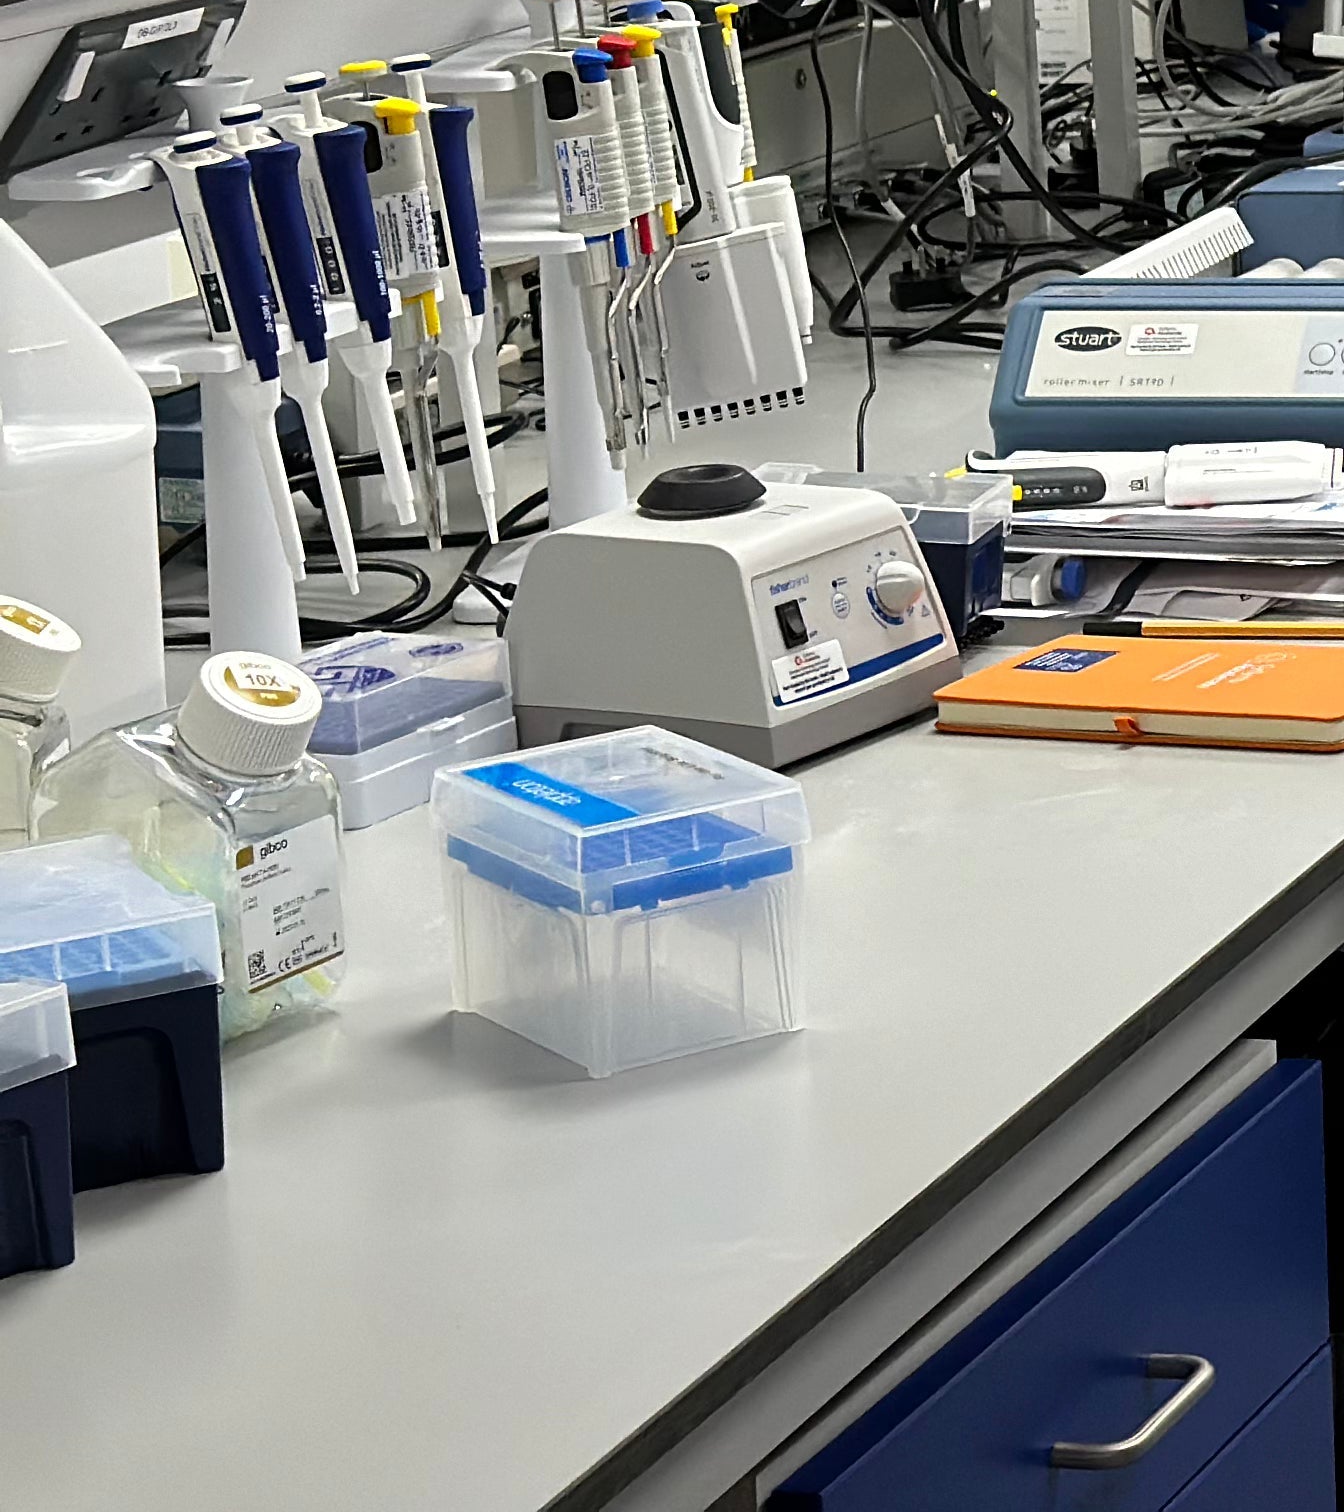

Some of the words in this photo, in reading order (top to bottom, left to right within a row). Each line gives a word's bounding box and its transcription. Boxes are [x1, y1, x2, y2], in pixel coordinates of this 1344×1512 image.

[1060, 330, 1115, 347] stuart
[245, 673, 282, 688] 10X
[260, 839, 288, 860] gibco
